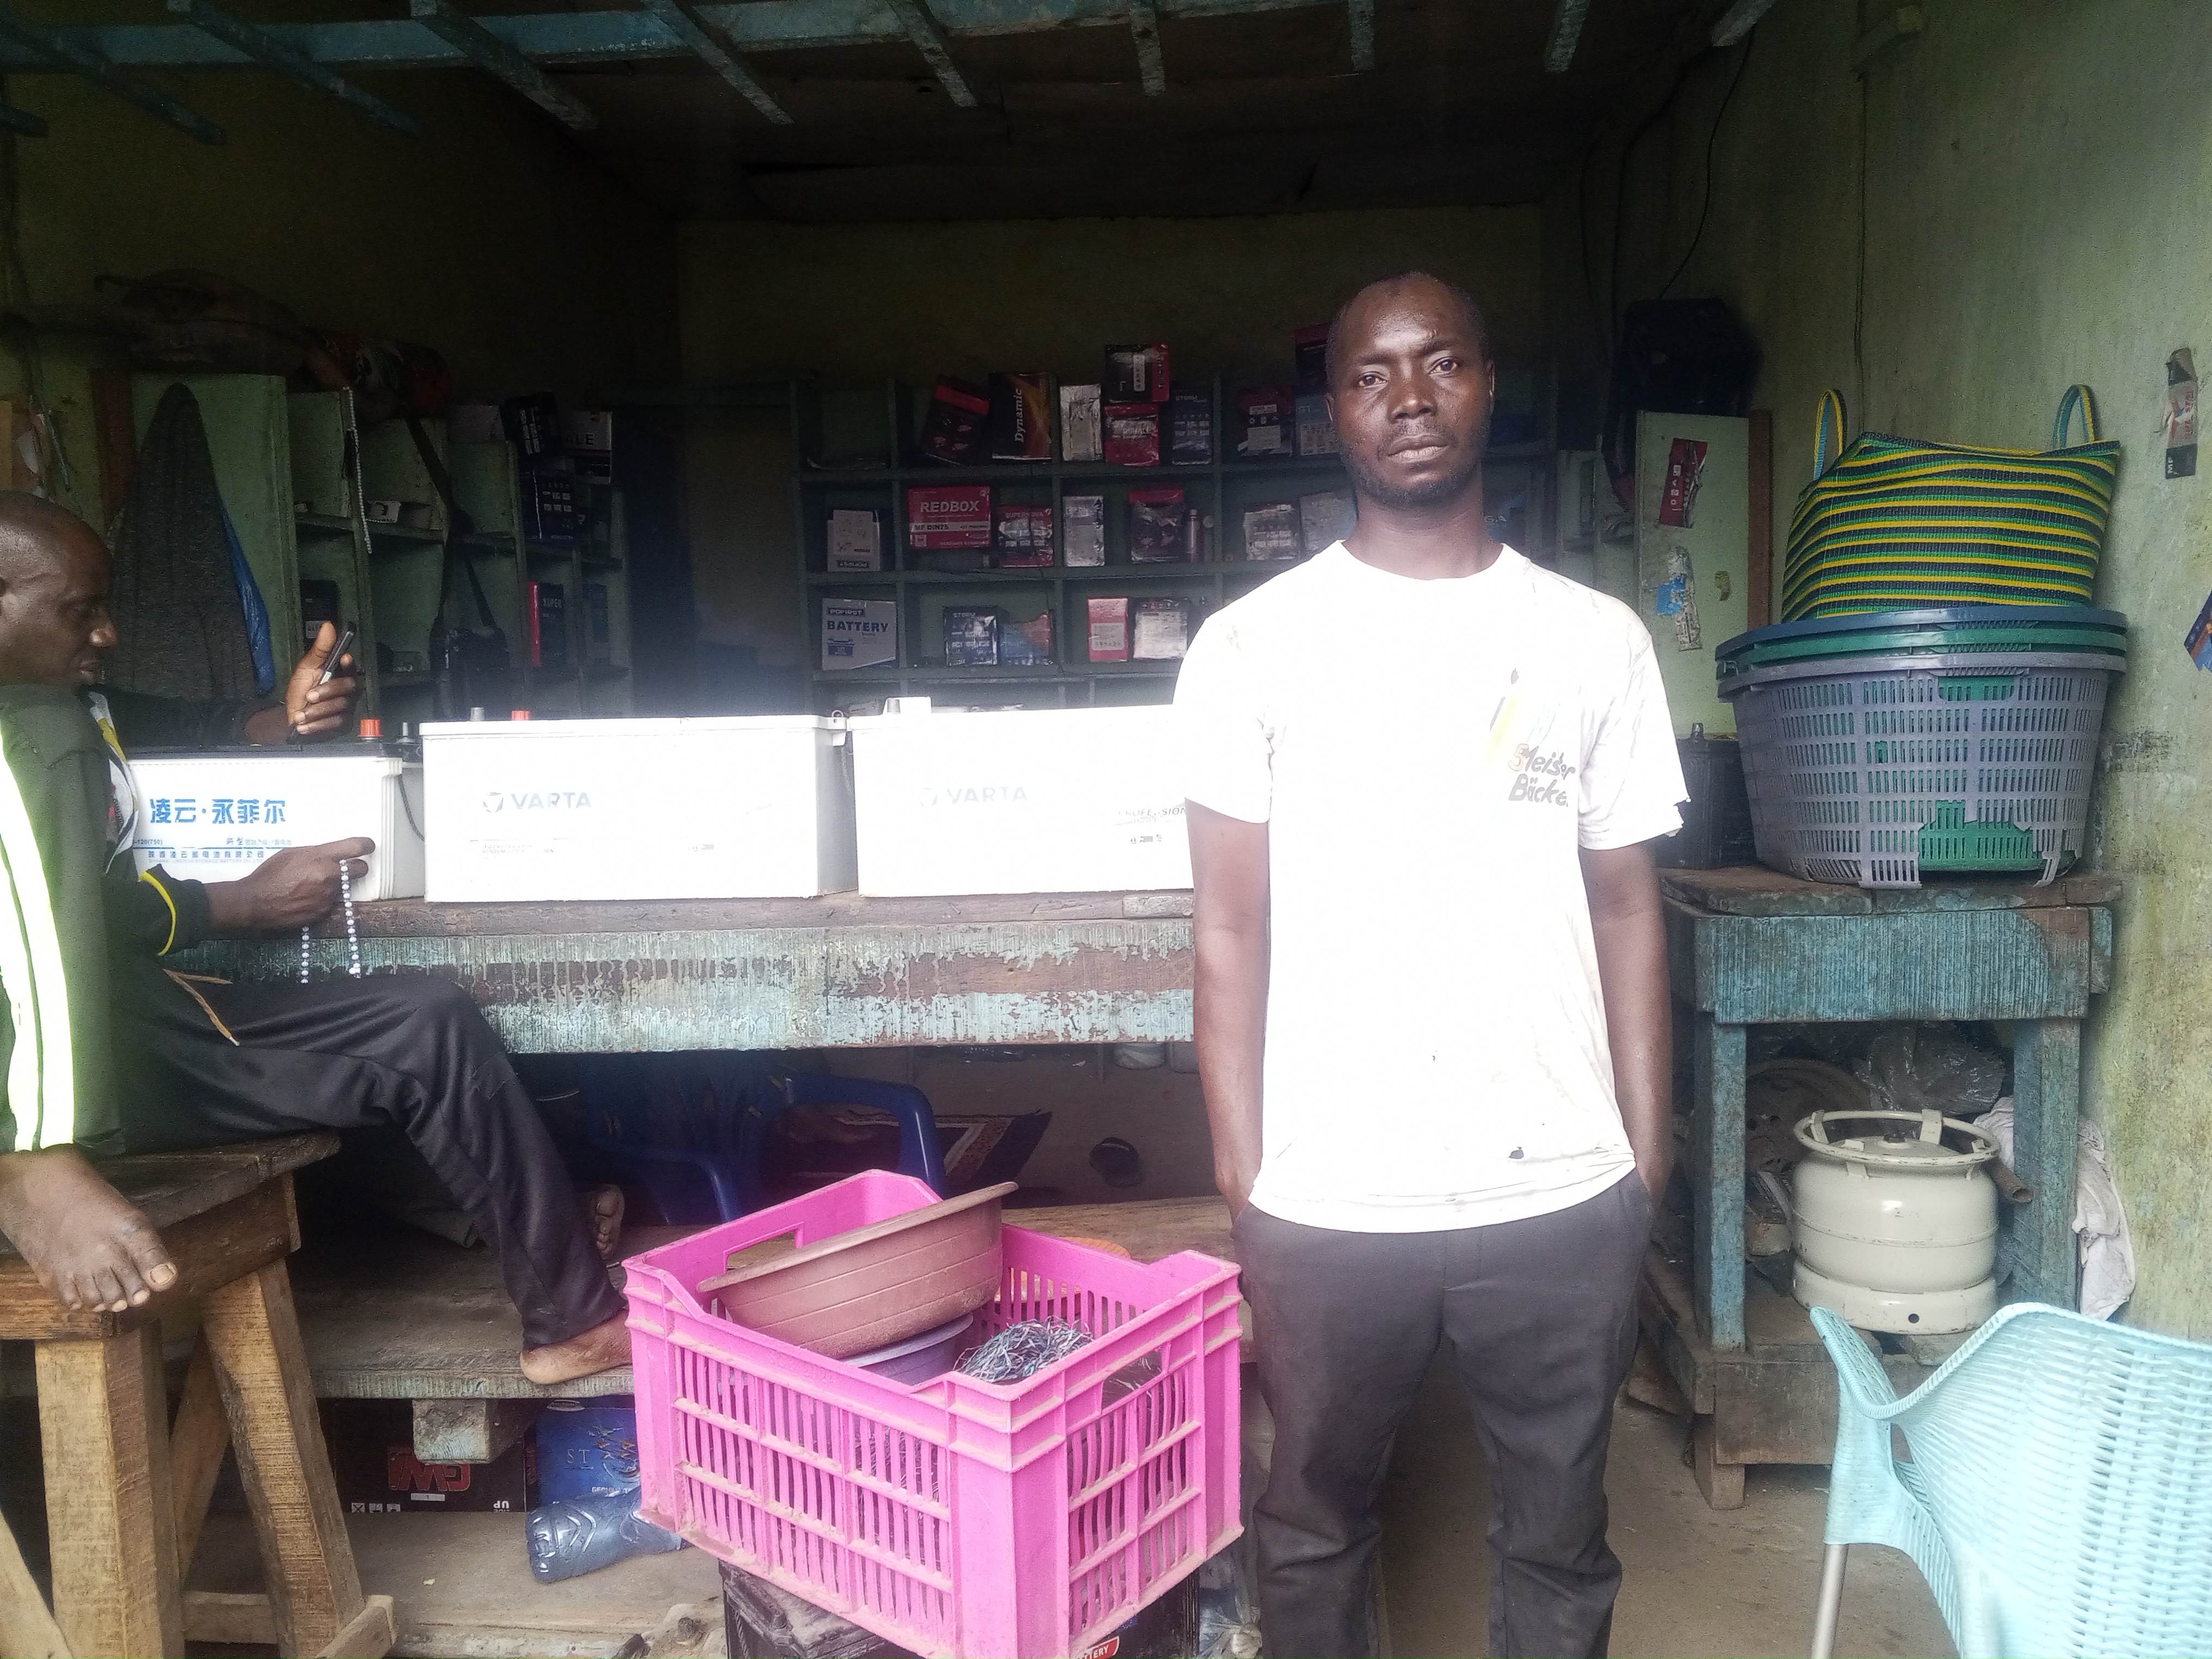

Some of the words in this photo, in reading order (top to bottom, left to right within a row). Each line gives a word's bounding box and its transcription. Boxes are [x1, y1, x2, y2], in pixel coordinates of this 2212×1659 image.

[1014, 388, 1026, 443] Dynamic
[920, 501, 980, 513] REDBOX
[827, 620, 889, 632] BATTERY
[946, 787, 1028, 804] VARTA
[1508, 773, 1568, 807] Bäcke
[511, 792, 592, 809] VARTA
[149, 798, 286, 824] 凌云·永菲尔
[493, 1500, 509, 1509] UP
